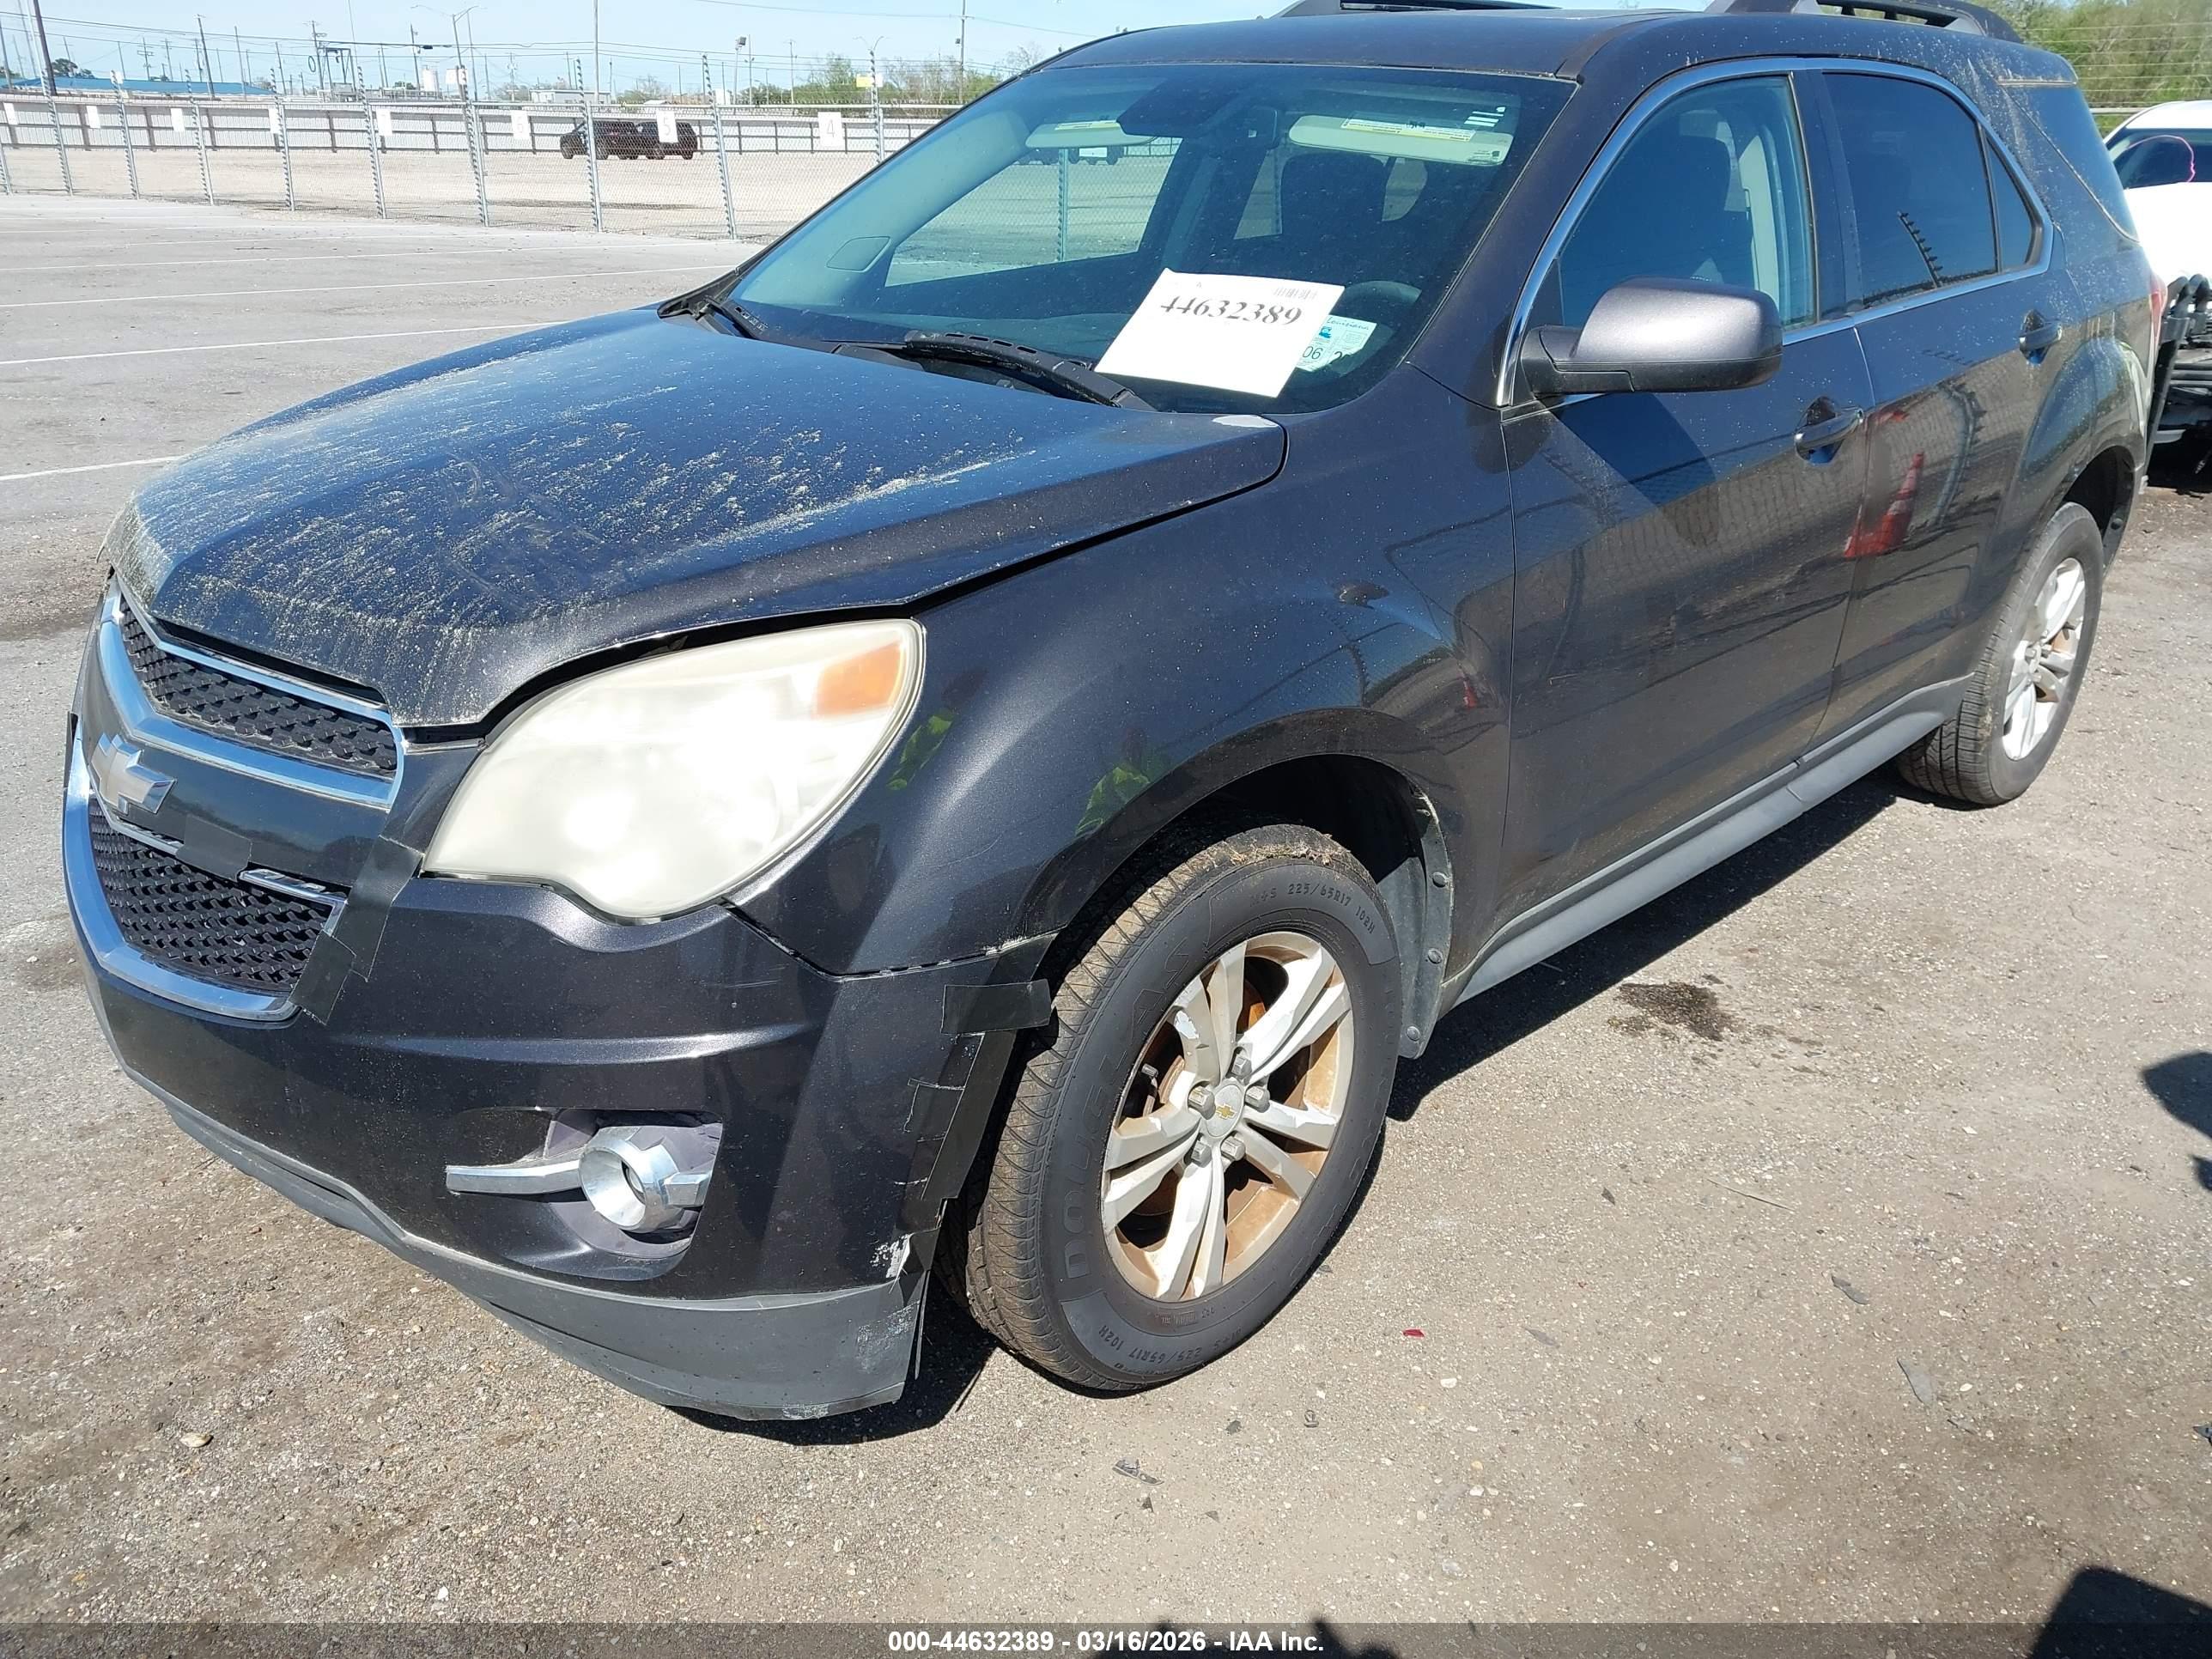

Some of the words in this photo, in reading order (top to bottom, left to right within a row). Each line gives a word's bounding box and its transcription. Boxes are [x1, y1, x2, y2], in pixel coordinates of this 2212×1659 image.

[663, 116, 671, 136] 5
[826, 119, 835, 137] 4
[1161, 296, 1302, 325] 44632389
[1303, 345, 1323, 360] 06
[1288, 883, 1352, 907] 225/65R17
[1355, 906, 1376, 934] 102H
[1098, 1324, 1125, 1351] 102H
[1128, 1346, 1202, 1364] 225/65R17
